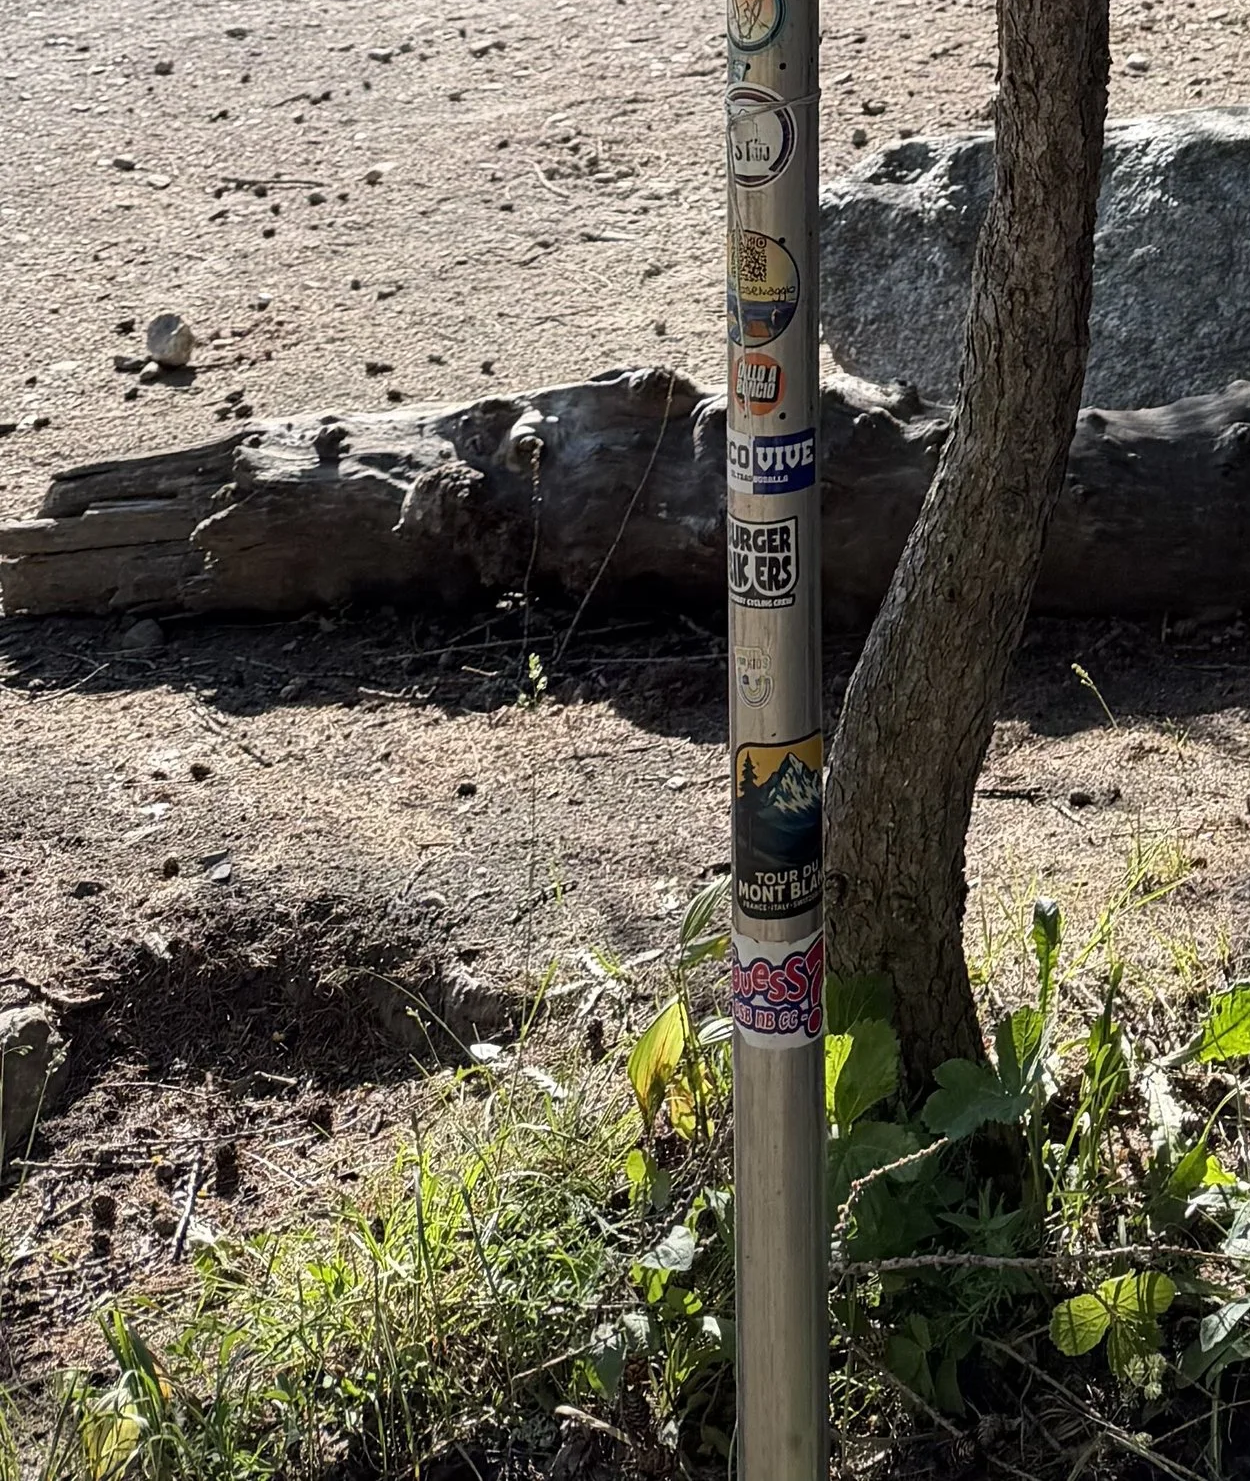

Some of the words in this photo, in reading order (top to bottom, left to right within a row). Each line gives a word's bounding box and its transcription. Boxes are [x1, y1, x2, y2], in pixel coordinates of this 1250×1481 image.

[756, 438, 814, 472] VIVE
[728, 522, 792, 554] URGER
[730, 551, 793, 592] IKERS
[738, 879, 786, 903] MONT
[790, 869, 826, 900] BLAN
[754, 869, 798, 886] TOUR
[802, 859, 819, 878] DU
